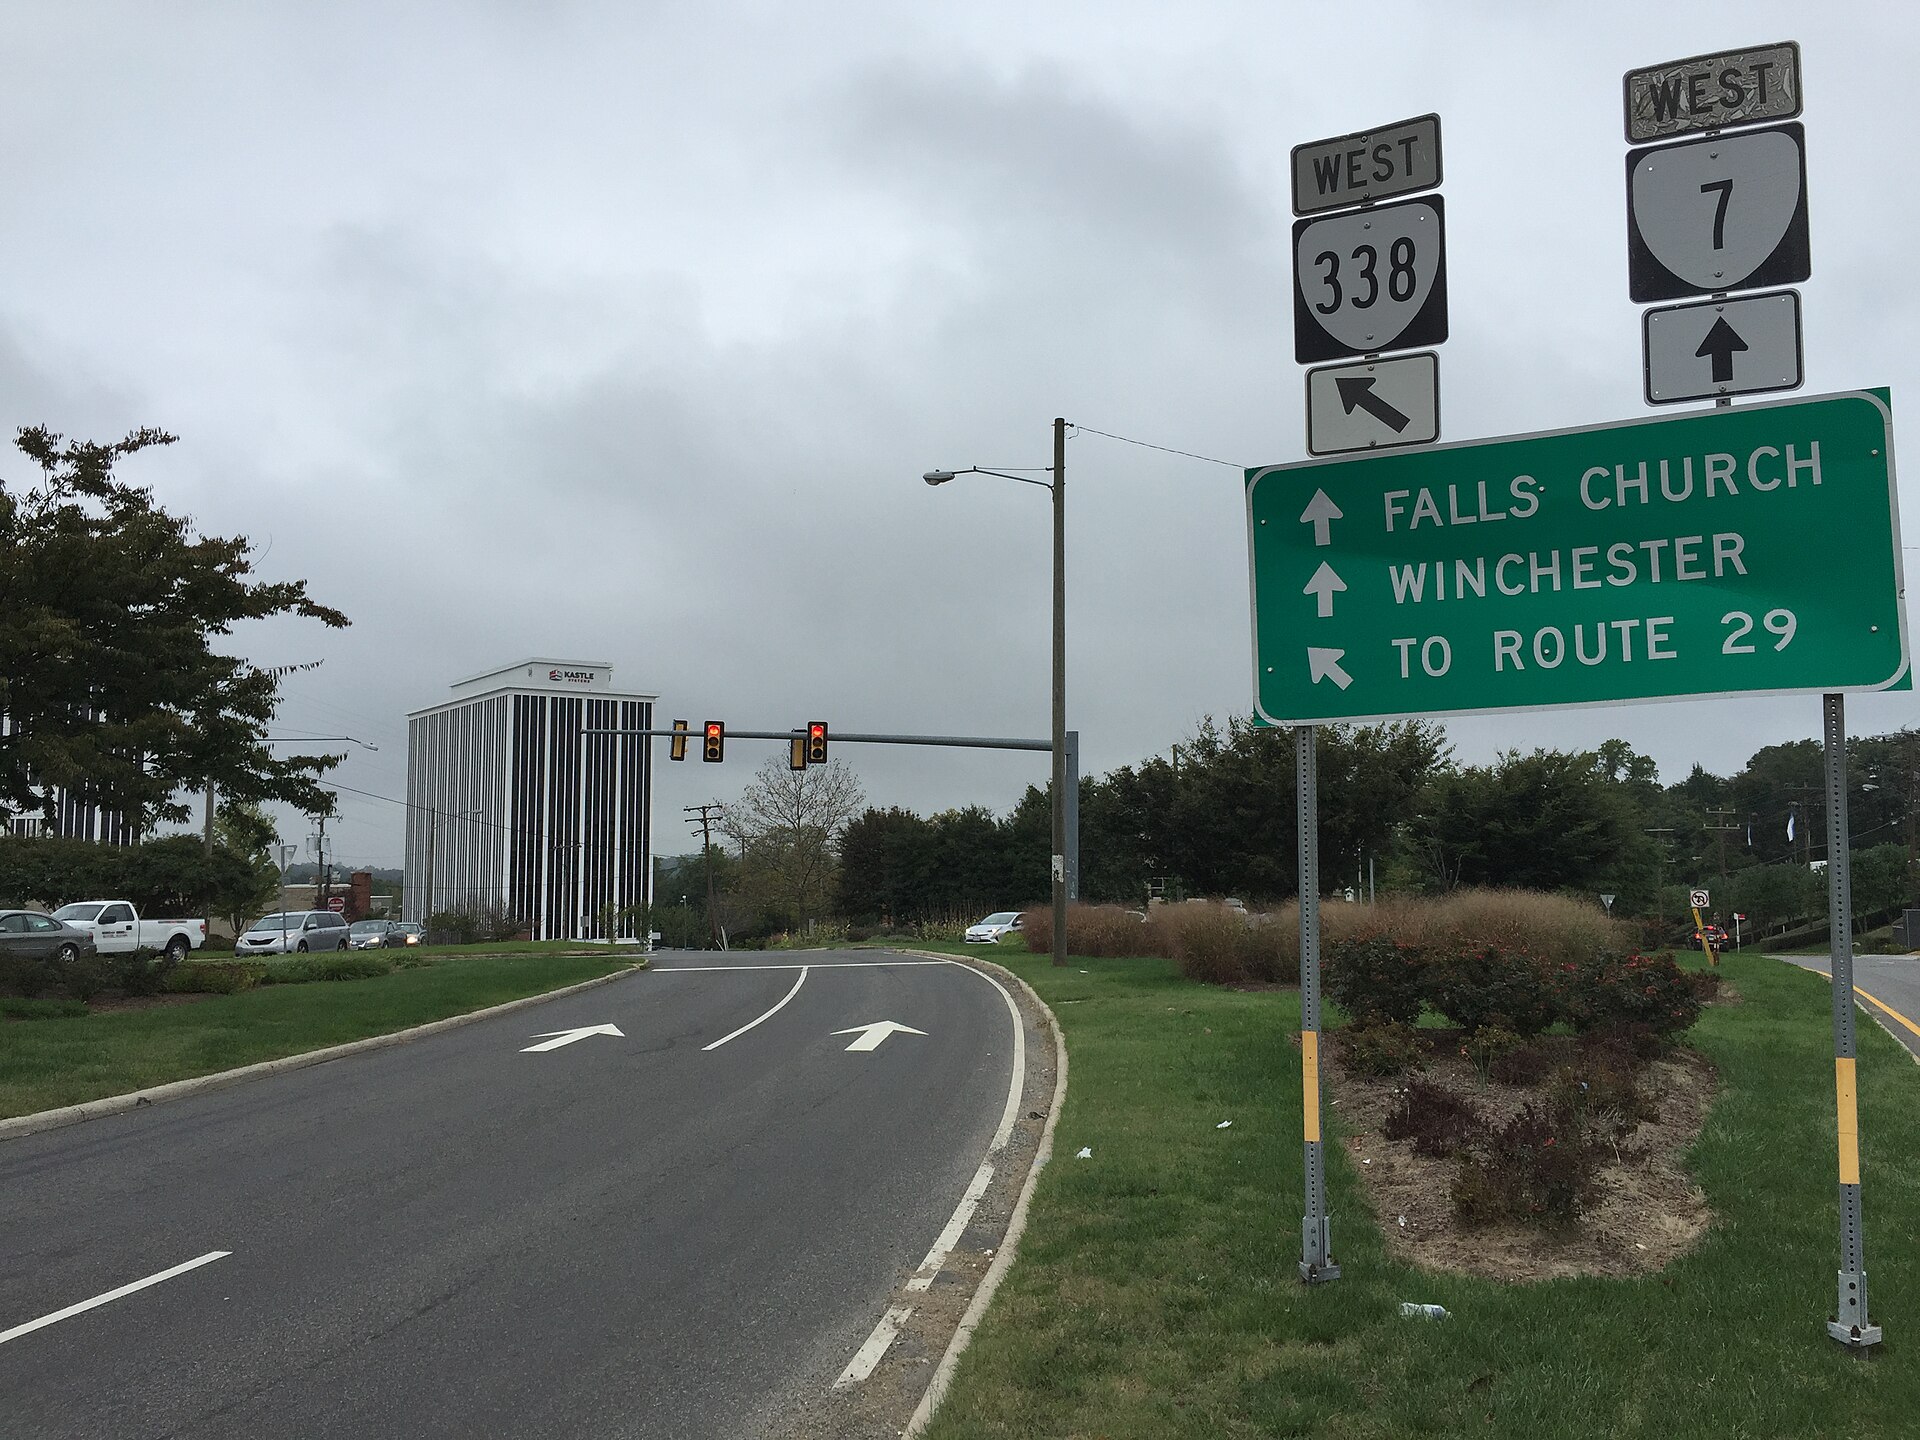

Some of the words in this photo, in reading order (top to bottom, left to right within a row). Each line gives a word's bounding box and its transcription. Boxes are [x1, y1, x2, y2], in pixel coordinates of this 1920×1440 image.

[1649, 61, 1774, 122] WEST
[1313, 135, 1419, 195] WEST
[1700, 178, 1734, 251] 7
[1314, 236, 1417, 315] 338
[1384, 475, 1540, 533] FALLS
[1580, 440, 1824, 511] CHURCH
[1389, 532, 1749, 604] WINCHESTER
[564, 671, 594, 679] KASTLE
[1392, 635, 1452, 678] TO
[1494, 617, 1677, 672] ROUTE
[1720, 609, 1798, 656] 29
